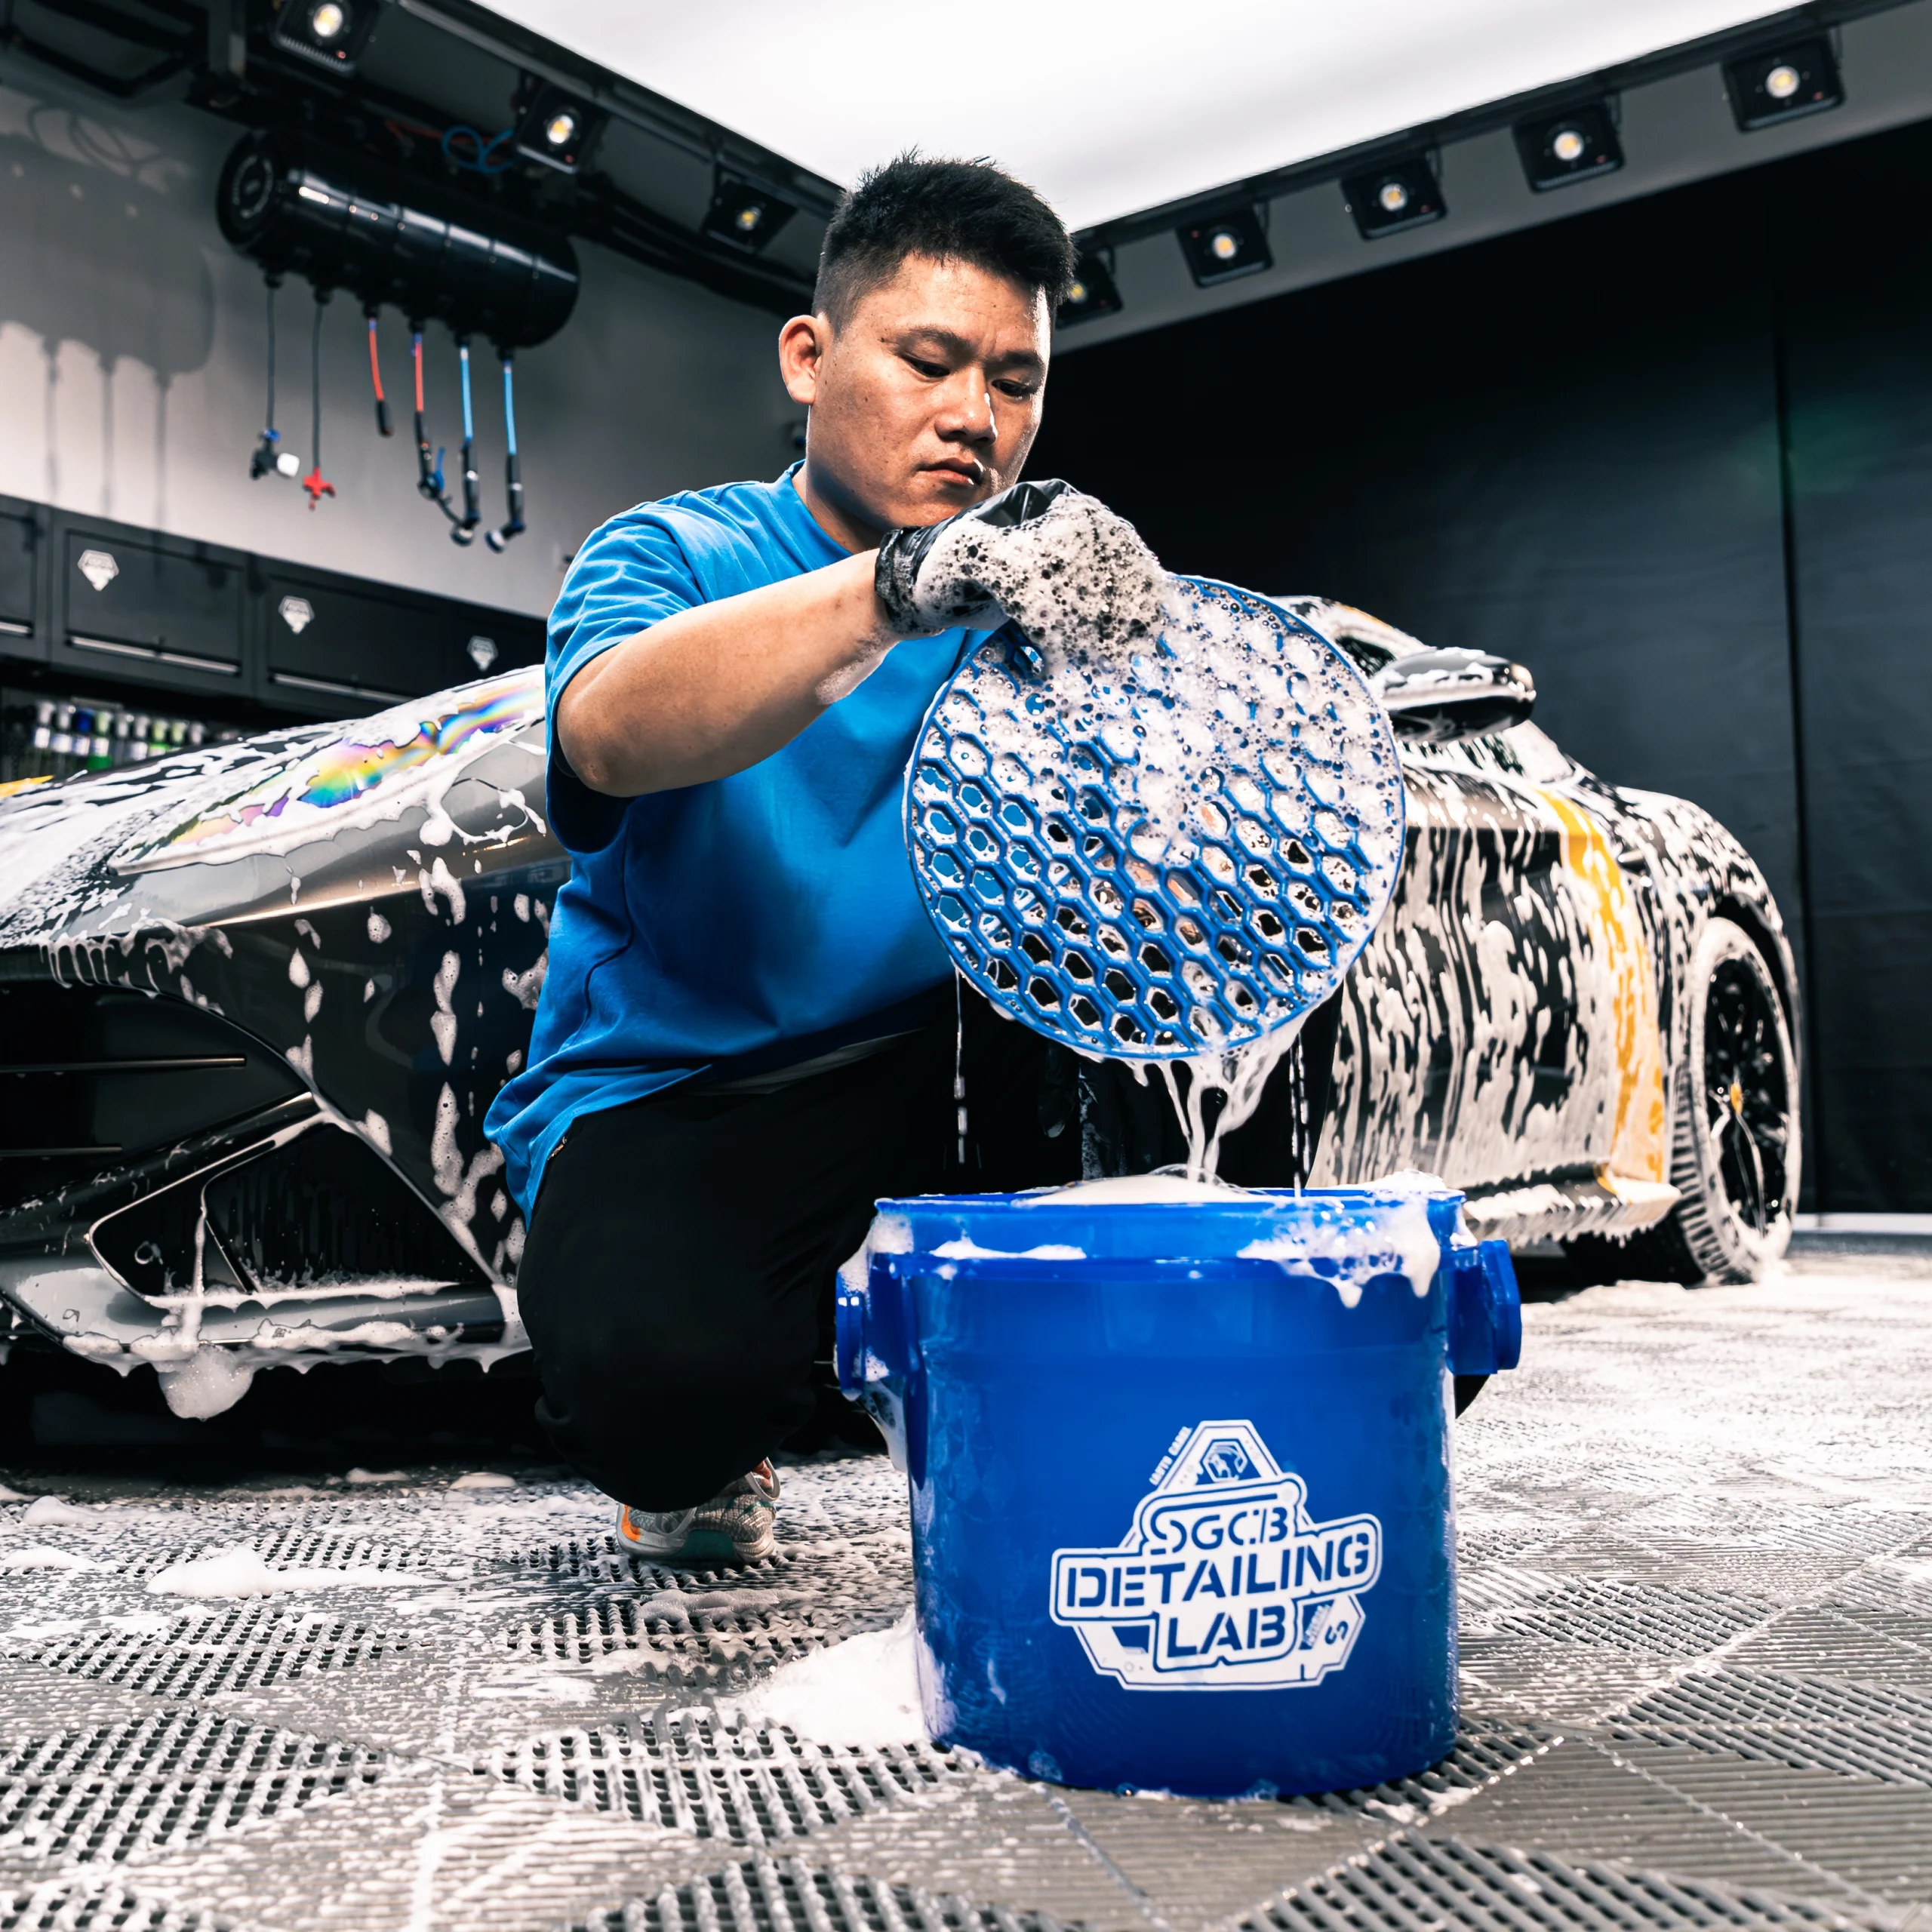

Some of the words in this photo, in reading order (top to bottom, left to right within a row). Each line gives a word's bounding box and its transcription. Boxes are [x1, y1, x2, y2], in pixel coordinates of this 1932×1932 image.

[1150, 1502, 1288, 1555] SGCB
[1066, 1533, 1370, 1607] DETAILING
[1167, 1605, 1286, 1658] LAB
